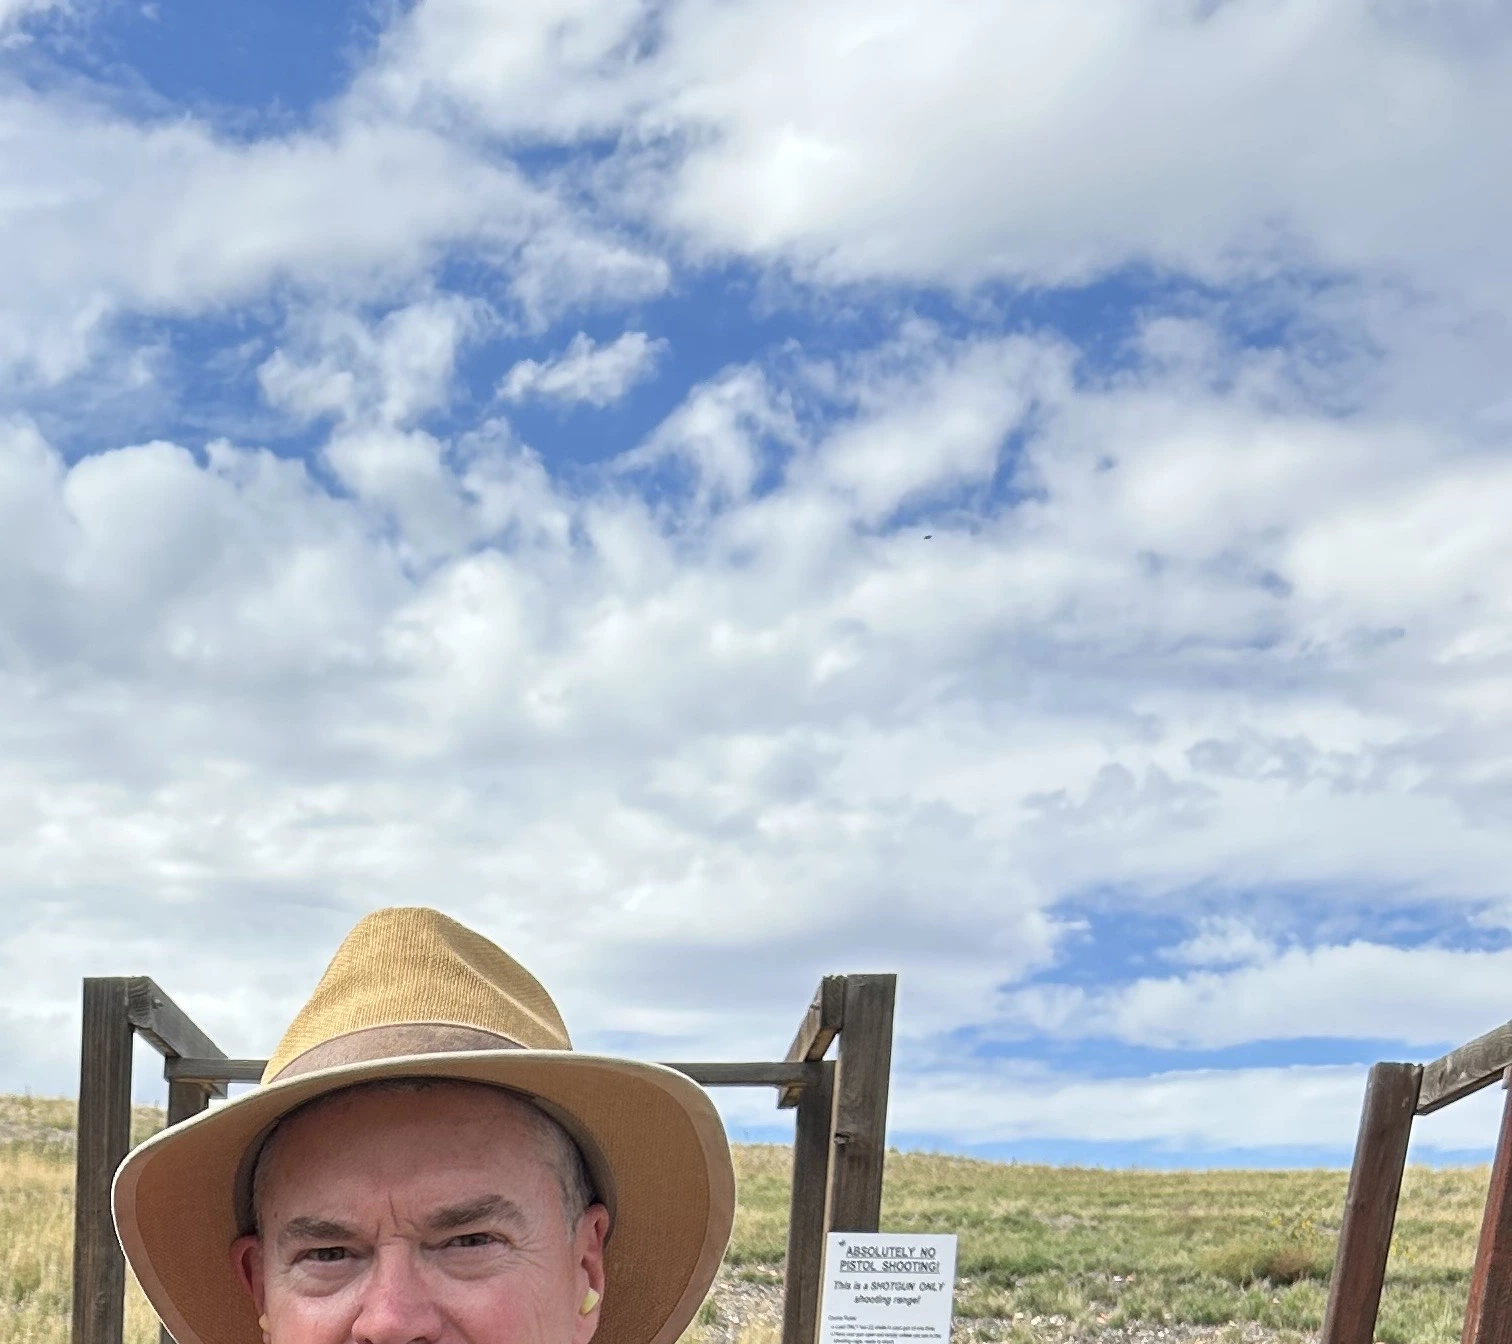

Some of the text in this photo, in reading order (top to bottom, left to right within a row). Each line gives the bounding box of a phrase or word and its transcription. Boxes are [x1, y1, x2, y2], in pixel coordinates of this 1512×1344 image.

[846, 1246, 936, 1259] ABSOLUTELY NO
[840, 1260, 940, 1273] PISTOL SHOOTING!
[834, 1280, 851, 1290] This
[853, 1281, 861, 1290] is
[871, 1281, 915, 1291] SHOTGUN
[919, 1282, 945, 1291] ONLY
[854, 1294, 891, 1306] shooting
